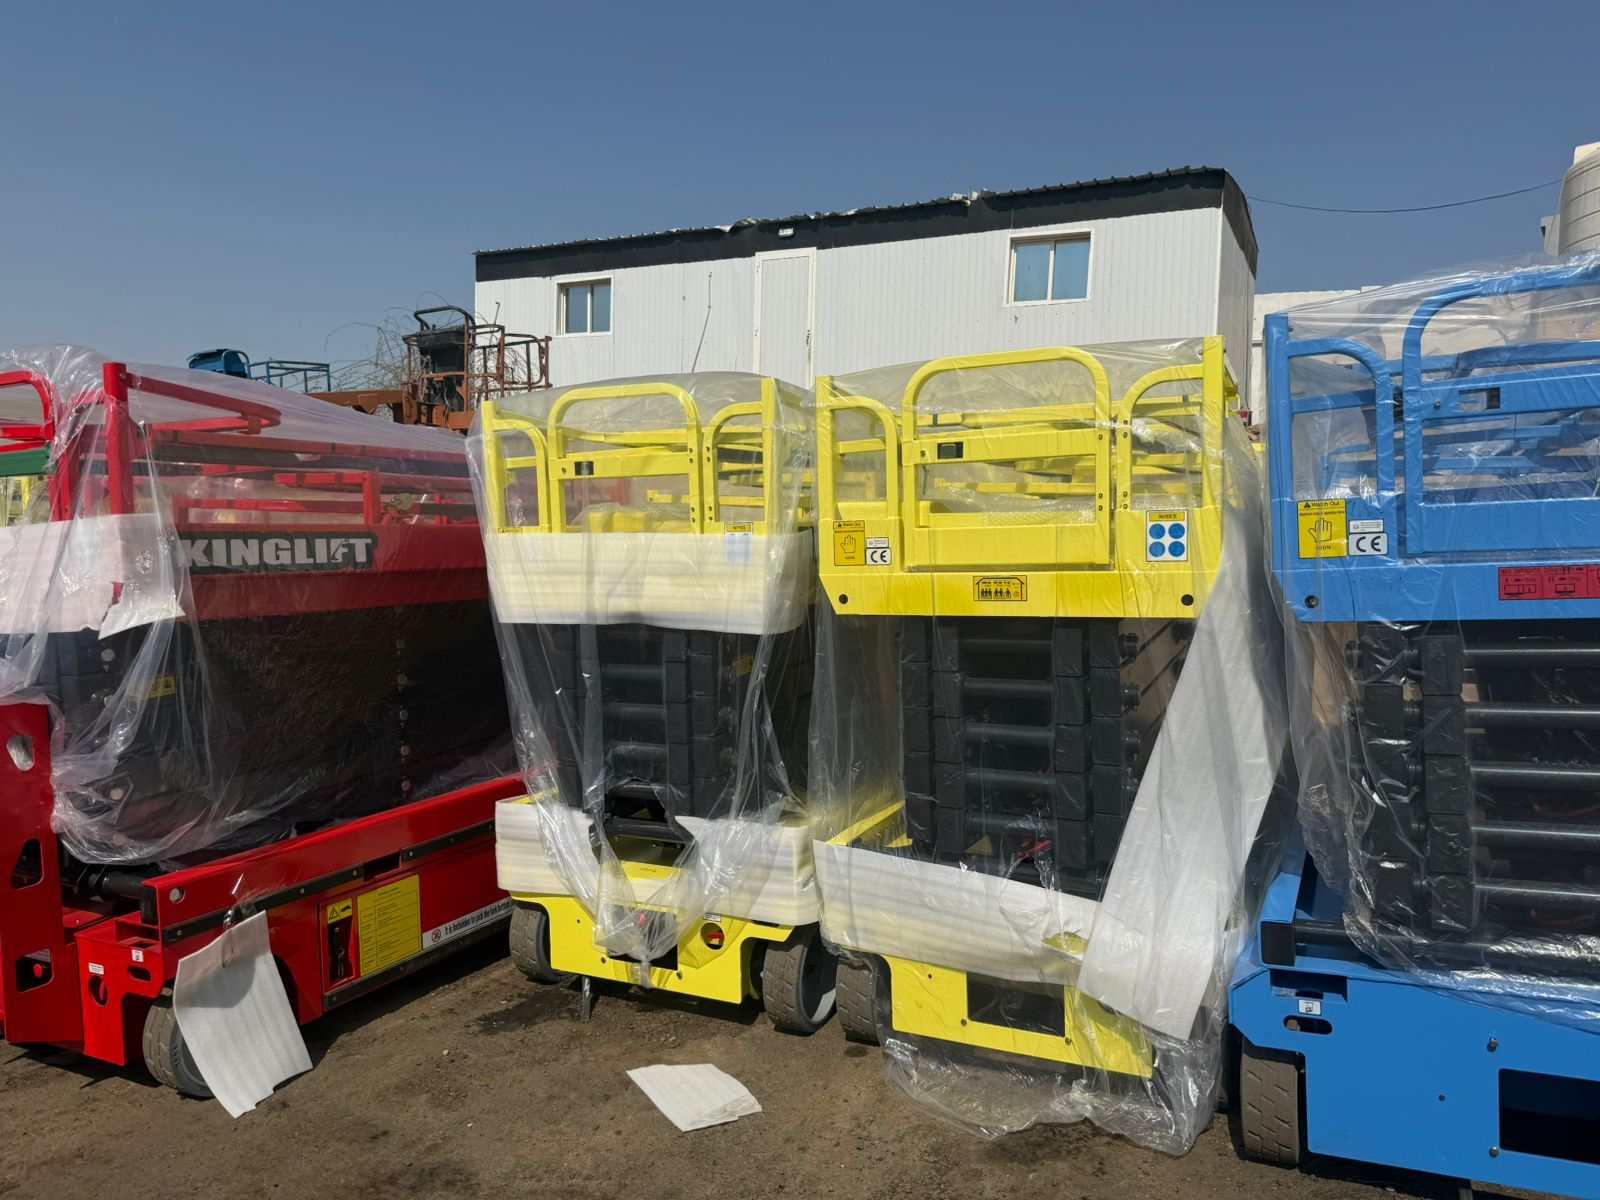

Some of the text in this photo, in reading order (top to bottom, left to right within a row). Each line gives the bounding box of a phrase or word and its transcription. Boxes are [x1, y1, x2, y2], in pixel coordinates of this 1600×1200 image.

[179, 537, 372, 568] KINGLIFT
[1356, 535, 1382, 552] CE
[871, 550, 888, 564] CE
[453, 918, 470, 931] forbidden
[475, 912, 483, 924] pick
